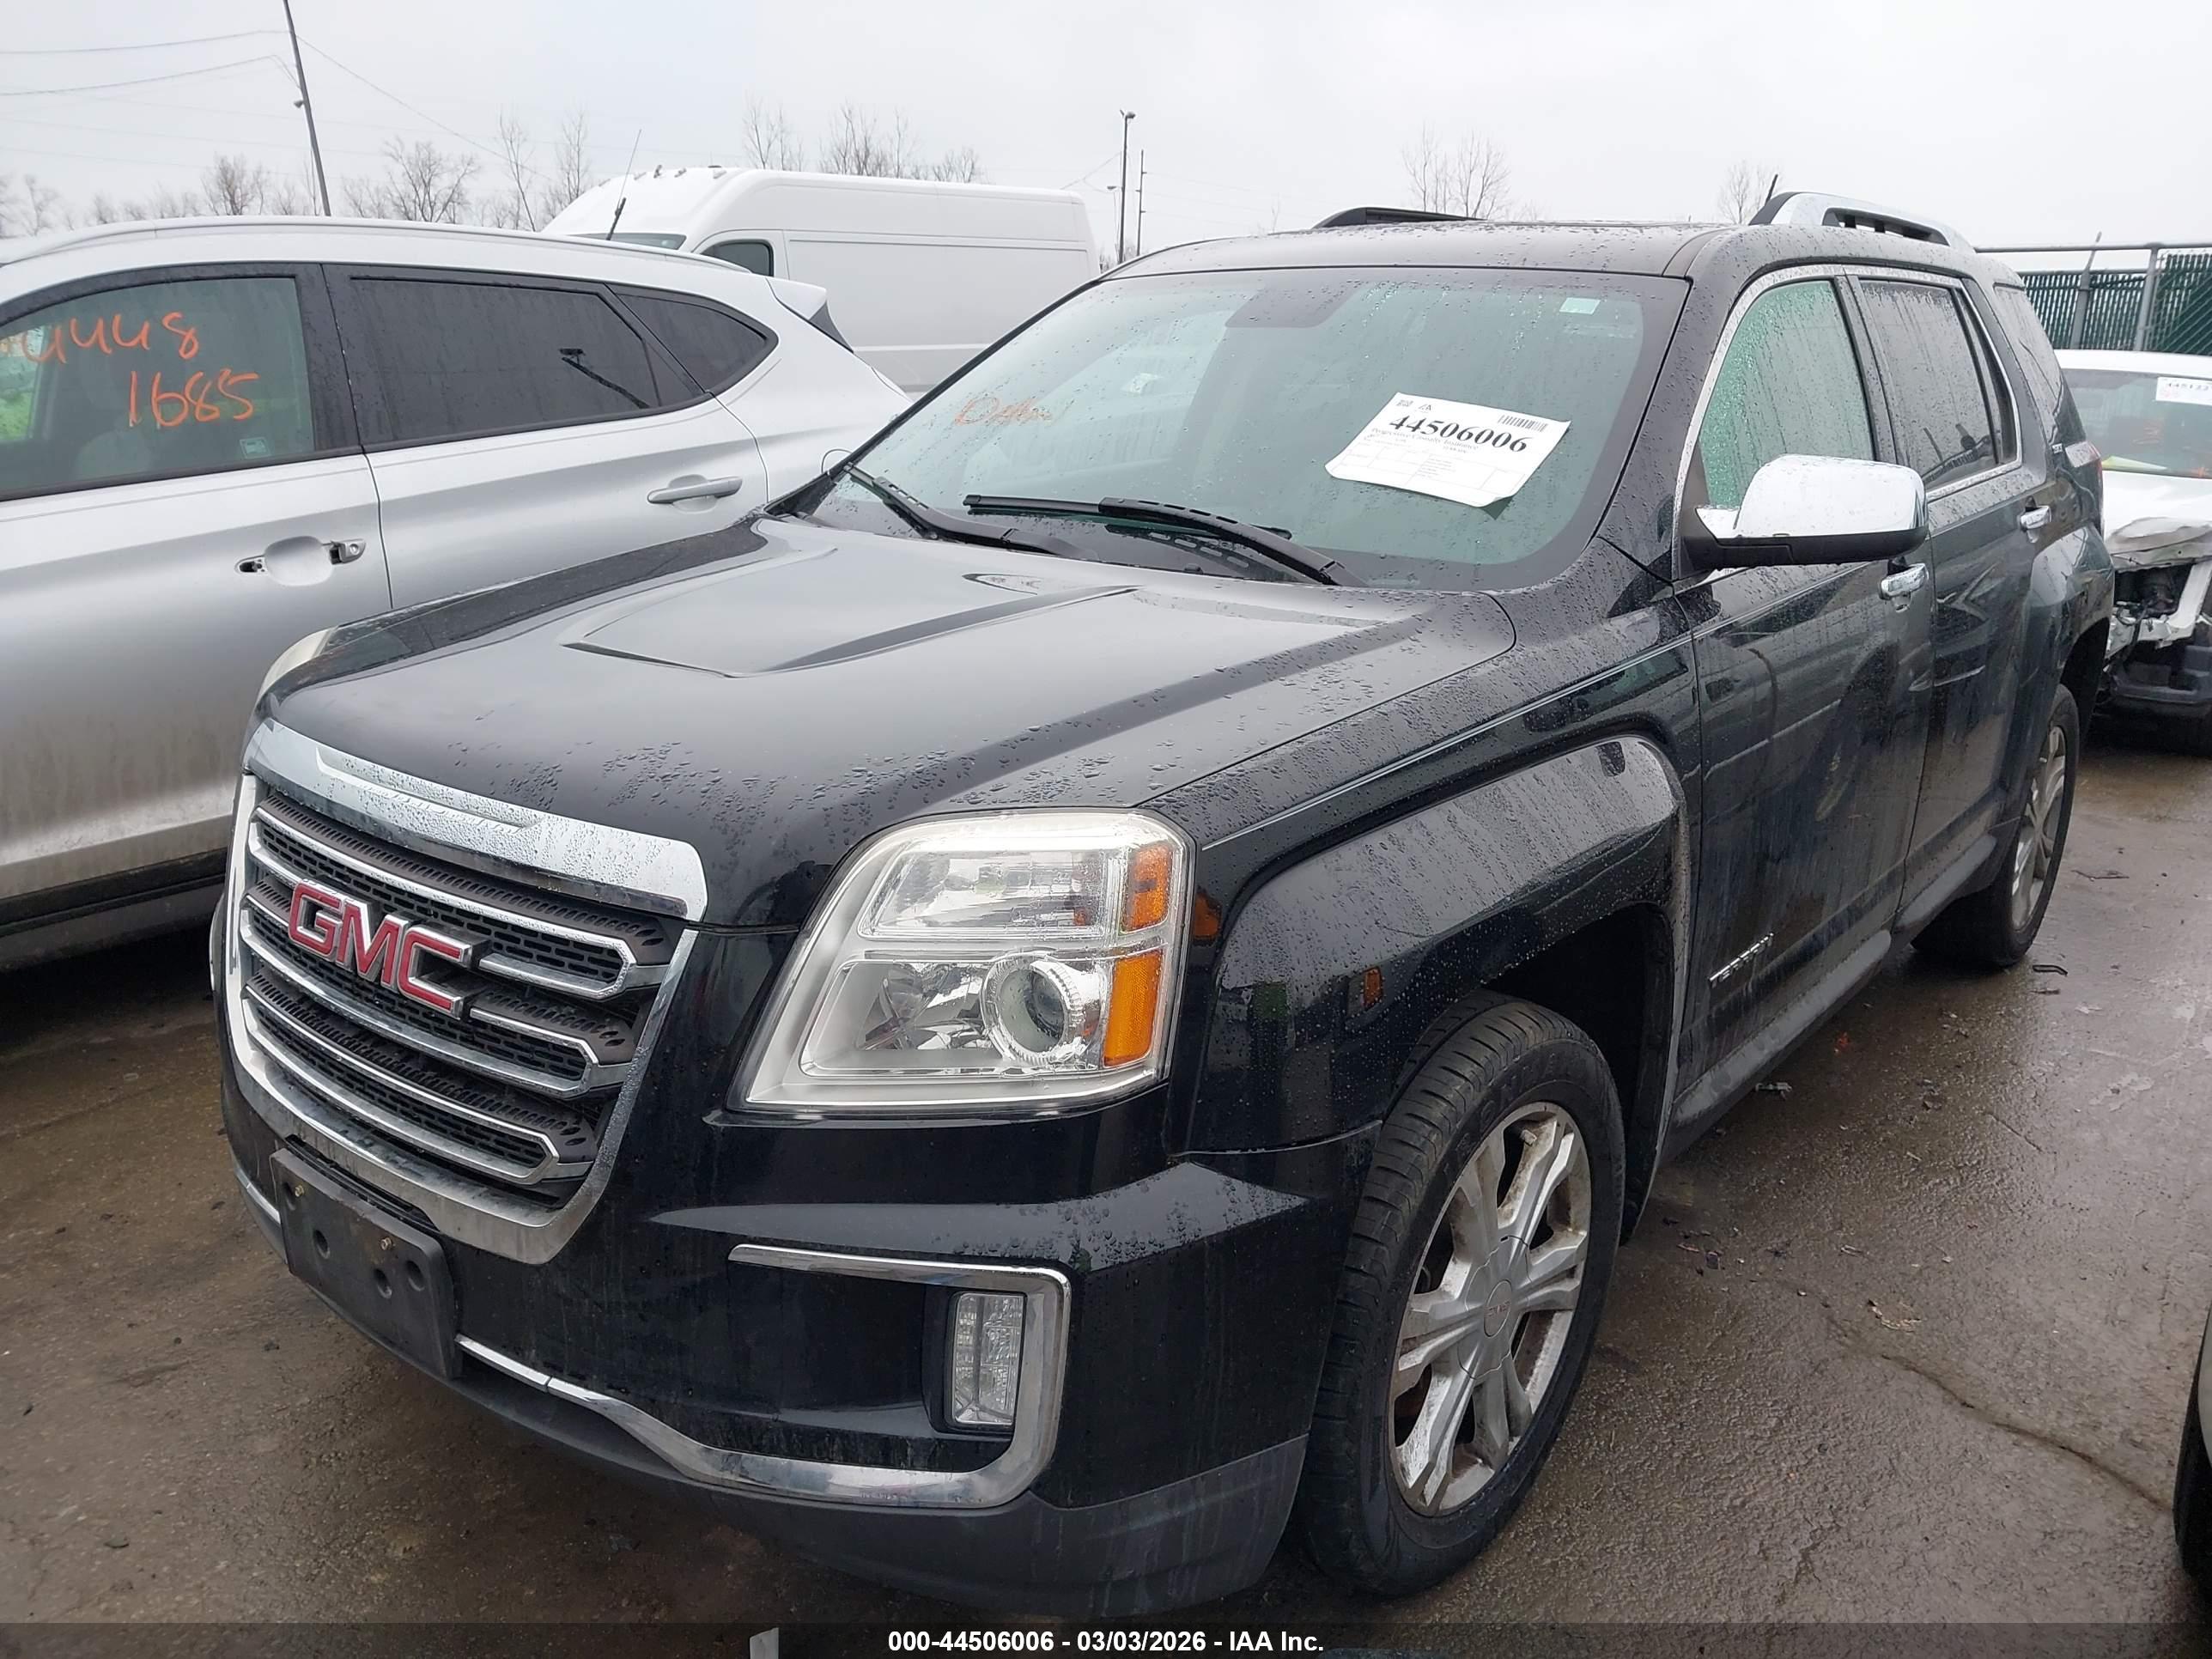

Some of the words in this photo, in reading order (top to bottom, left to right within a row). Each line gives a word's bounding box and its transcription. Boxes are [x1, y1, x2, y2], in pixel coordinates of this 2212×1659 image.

[129, 368, 260, 429] 1685
[1389, 414, 1534, 453] 44506006
[288, 878, 473, 1020] GMC
